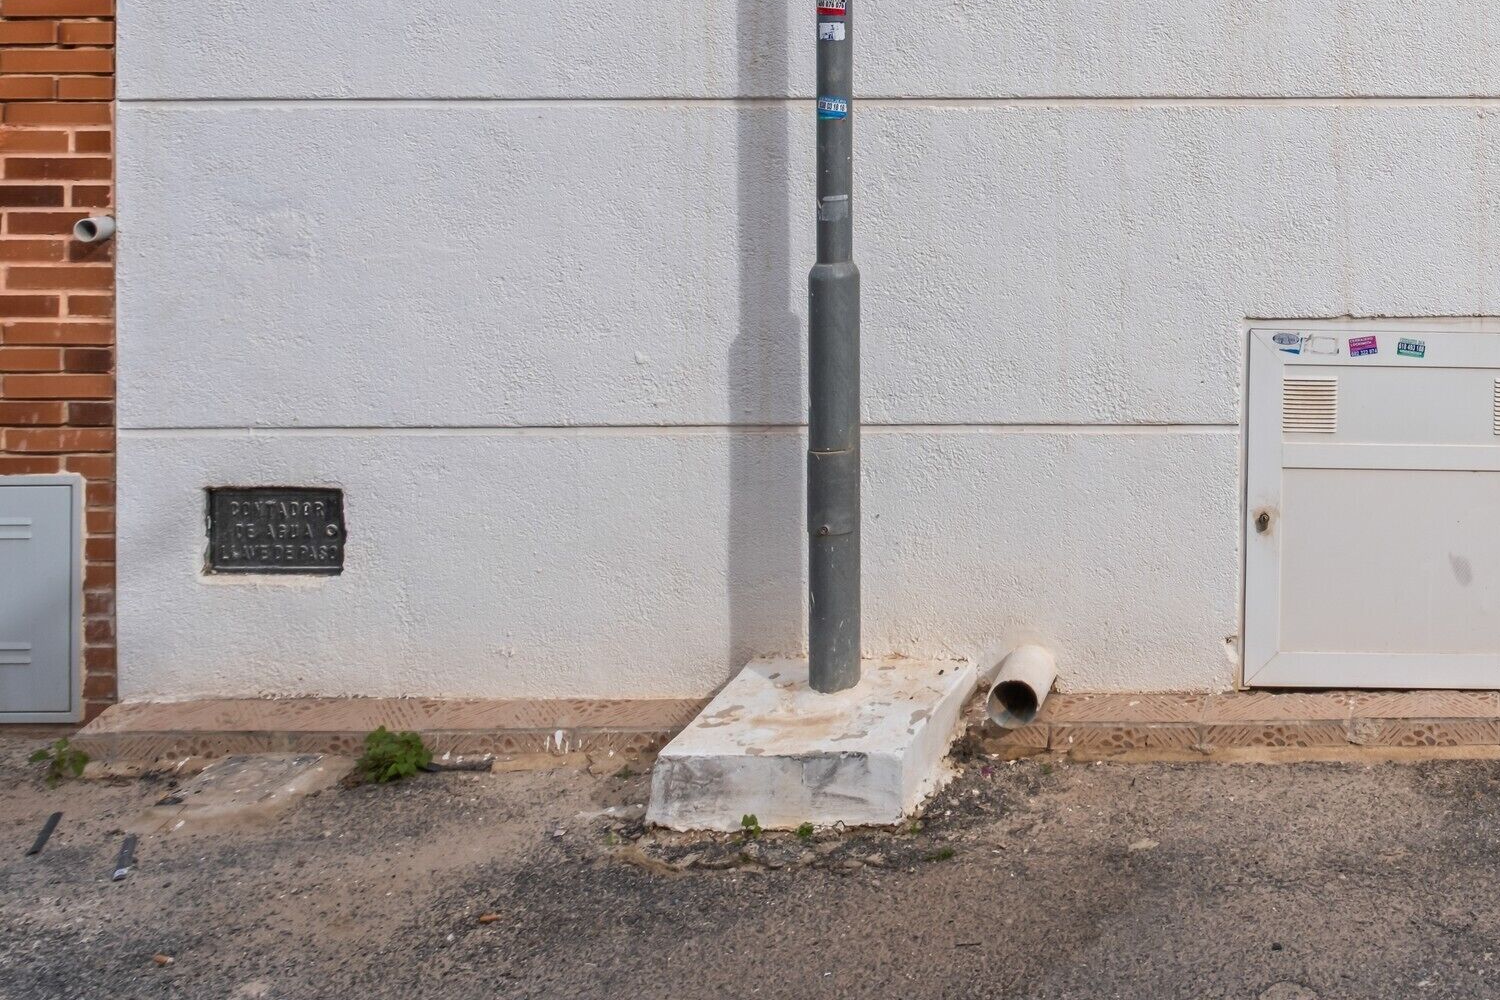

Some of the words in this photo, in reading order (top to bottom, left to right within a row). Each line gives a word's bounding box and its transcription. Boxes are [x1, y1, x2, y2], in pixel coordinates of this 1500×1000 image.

[230, 499, 325, 518] CONTADOR
[235, 522, 256, 538] DE
[267, 523, 314, 539] AGUA
[299, 544, 338, 560] PASO
